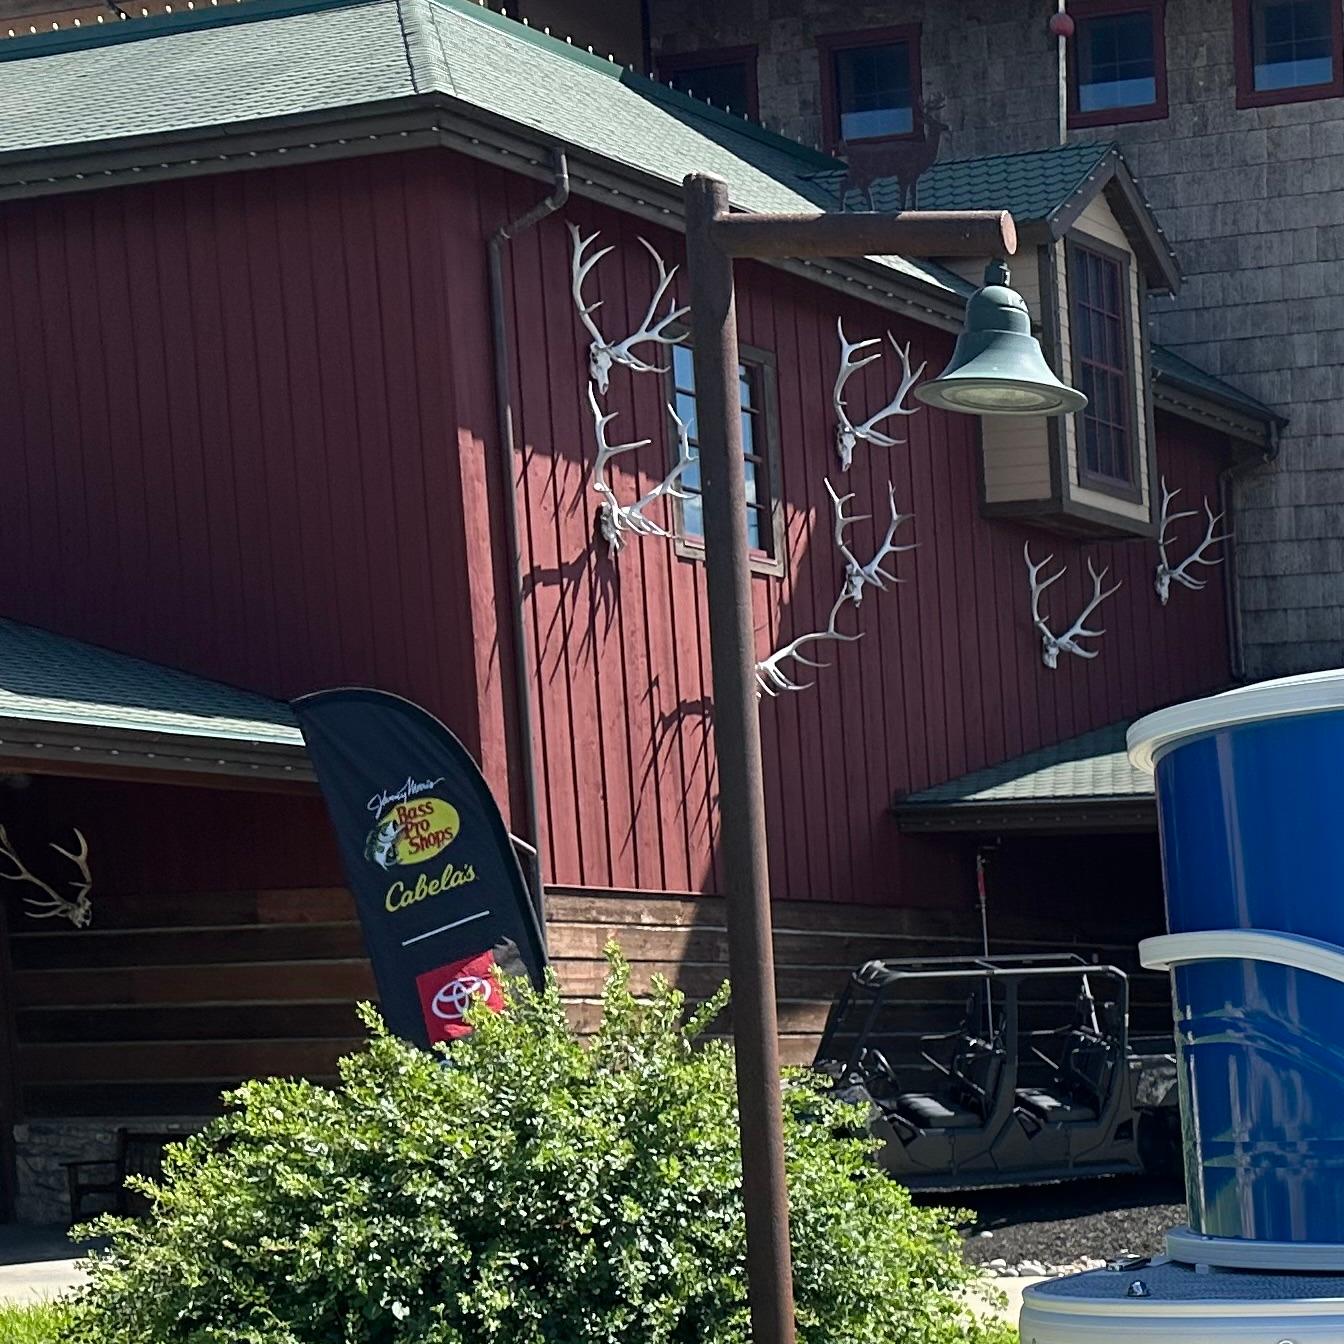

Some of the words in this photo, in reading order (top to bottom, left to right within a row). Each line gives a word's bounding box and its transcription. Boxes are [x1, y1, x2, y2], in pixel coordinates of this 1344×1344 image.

[396, 801, 435, 824] Bass
[403, 819, 431, 839] Pro
[408, 826, 454, 855] Shops
[385, 863, 476, 914] Cabela's
